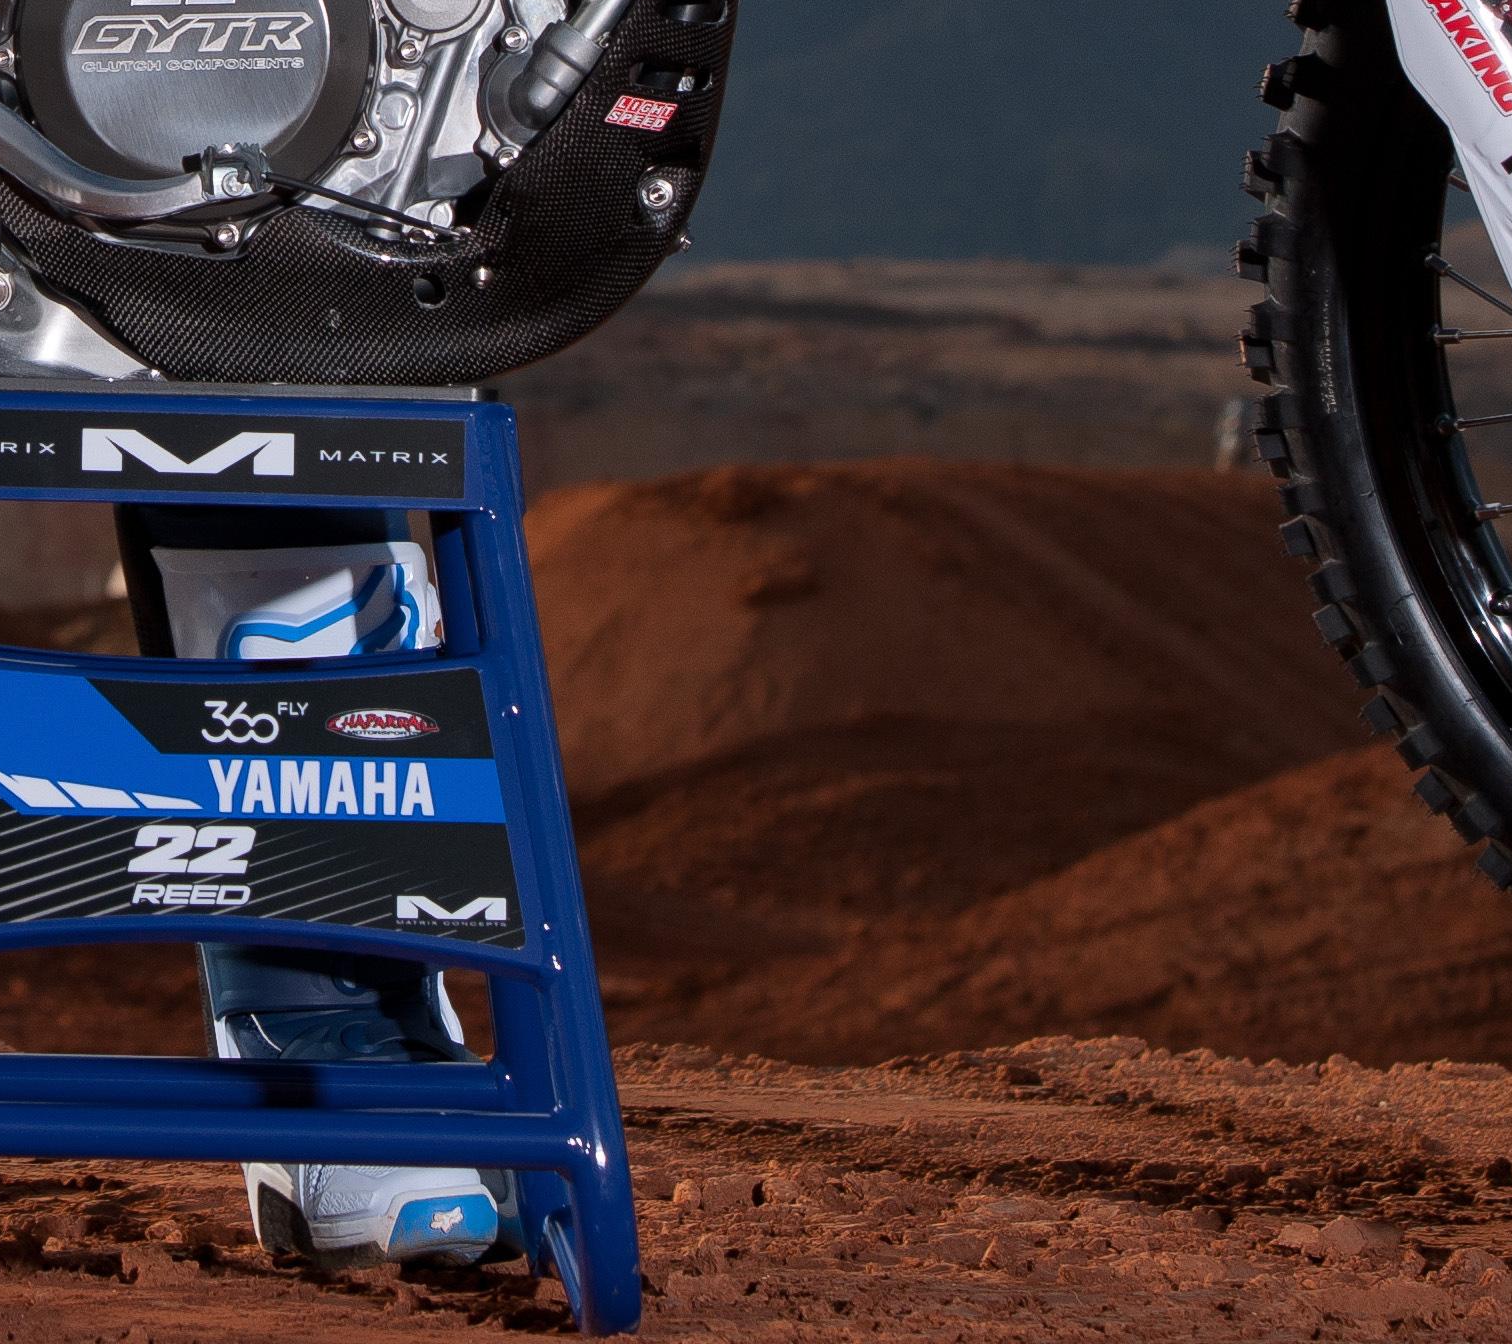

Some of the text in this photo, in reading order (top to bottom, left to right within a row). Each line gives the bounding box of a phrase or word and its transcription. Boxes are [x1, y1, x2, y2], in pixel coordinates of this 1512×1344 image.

[72, 12, 314, 54] GYTR
[81, 57, 305, 73] CLUTCH COMPONENTS
[617, 97, 675, 116] LIGHT
[607, 112, 666, 128] SPEED
[319, 448, 449, 465] MATRIX
[201, 700, 309, 744] 360 FLY
[327, 713, 440, 734] CHAPARRAL
[207, 758, 435, 817] YAMAHA
[127, 825, 258, 874] 22
[132, 883, 252, 906] REED
